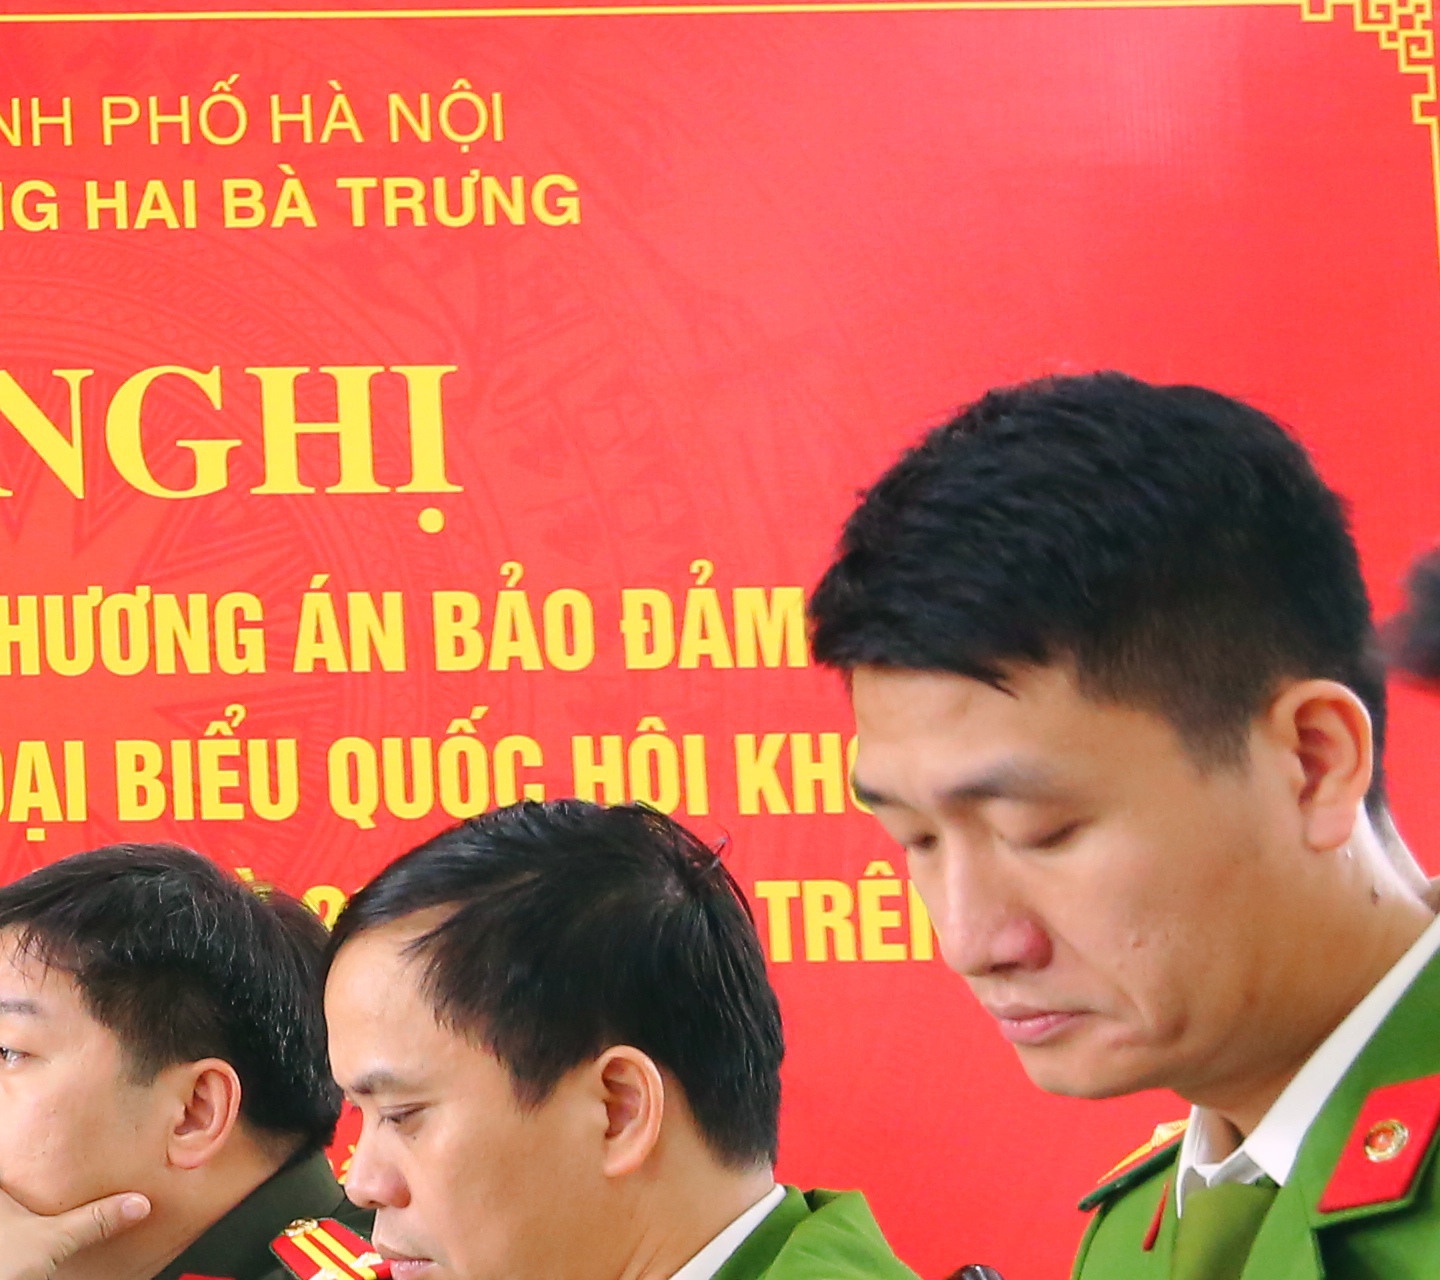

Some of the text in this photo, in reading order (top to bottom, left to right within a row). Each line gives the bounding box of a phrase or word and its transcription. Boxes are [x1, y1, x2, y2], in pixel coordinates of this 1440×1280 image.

[102, 74, 247, 145] PHỐ
[270, 80, 364, 143] HÀ
[388, 78, 504, 152] NỘI
[86, 179, 197, 230] HAI
[223, 164, 317, 228] BÀ
[336, 169, 581, 227] TRƯNG
[293, 574, 406, 673] ÁN
[432, 561, 595, 671] BẢO
[620, 559, 808, 669] ĐẢM
[115, 704, 299, 821] BIỂU
[328, 706, 545, 829] QUỐC
